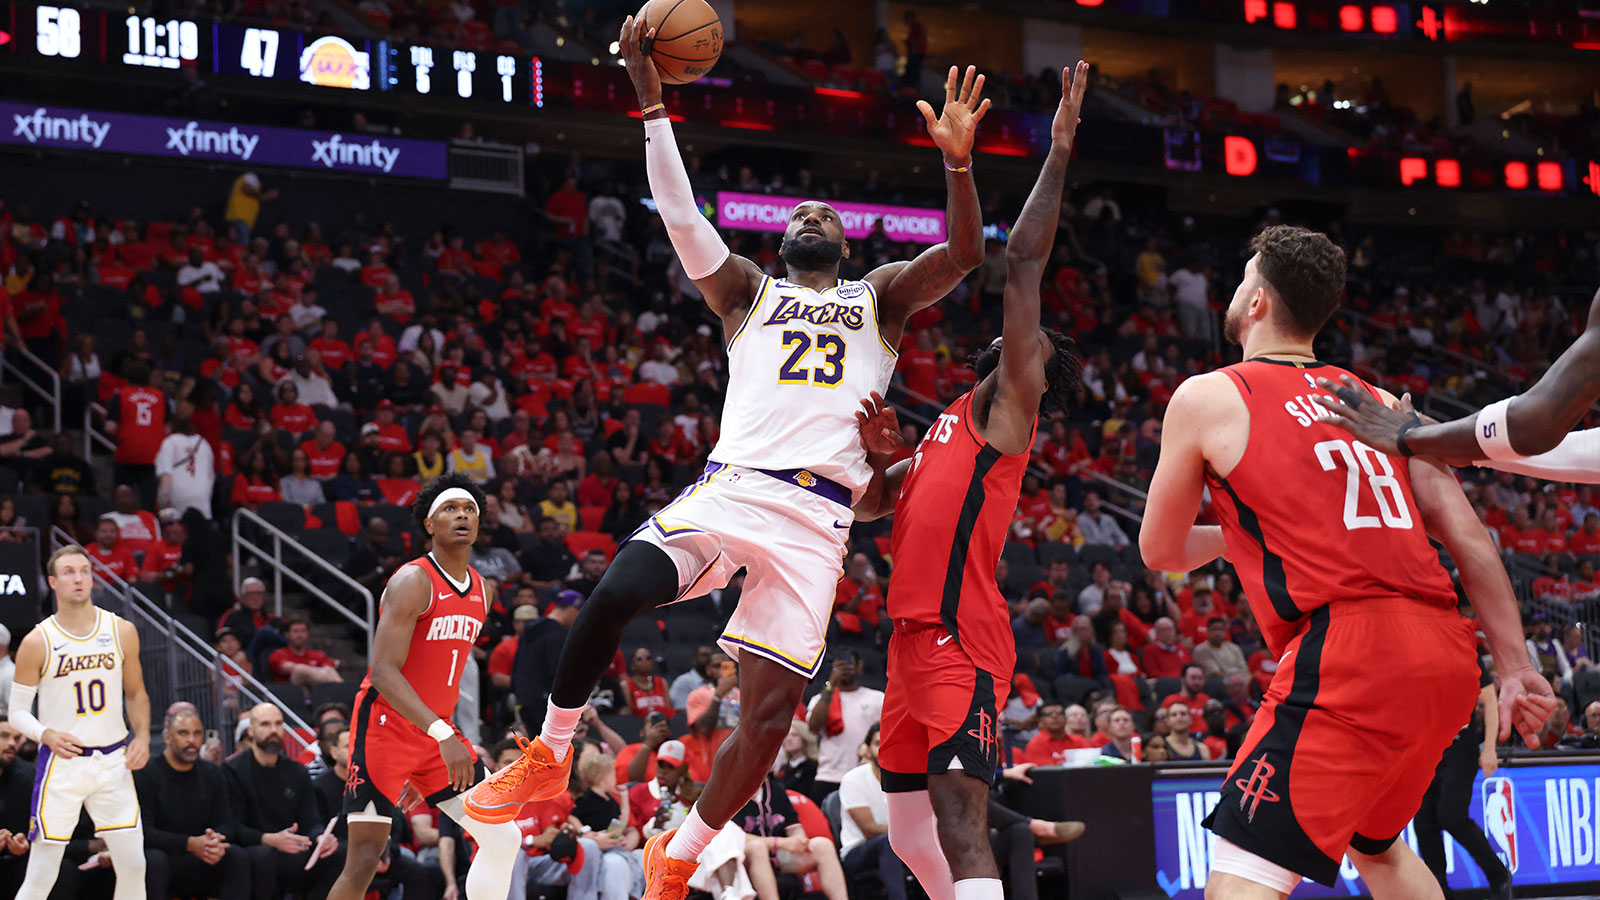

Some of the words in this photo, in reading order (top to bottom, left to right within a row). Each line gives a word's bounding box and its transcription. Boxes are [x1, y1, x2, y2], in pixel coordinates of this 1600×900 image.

[36, 5, 81, 58] 58
[125, 15, 198, 60] 11:19
[240, 28, 279, 78] 47
[501, 75, 512, 102] 1
[13, 108, 111, 148] xfinity
[166, 121, 259, 160] xfinity
[311, 134, 400, 172] xfinity
[724, 201, 787, 221] OFFICIA
[761, 295, 865, 331] LAKERS
[777, 329, 848, 390] 23
[1313, 439, 1413, 530] 28
[53, 652, 115, 678] LAKERS
[447, 649, 458, 687] 1
[73, 678, 106, 717] 10
[1545, 777, 1600, 868] NB
